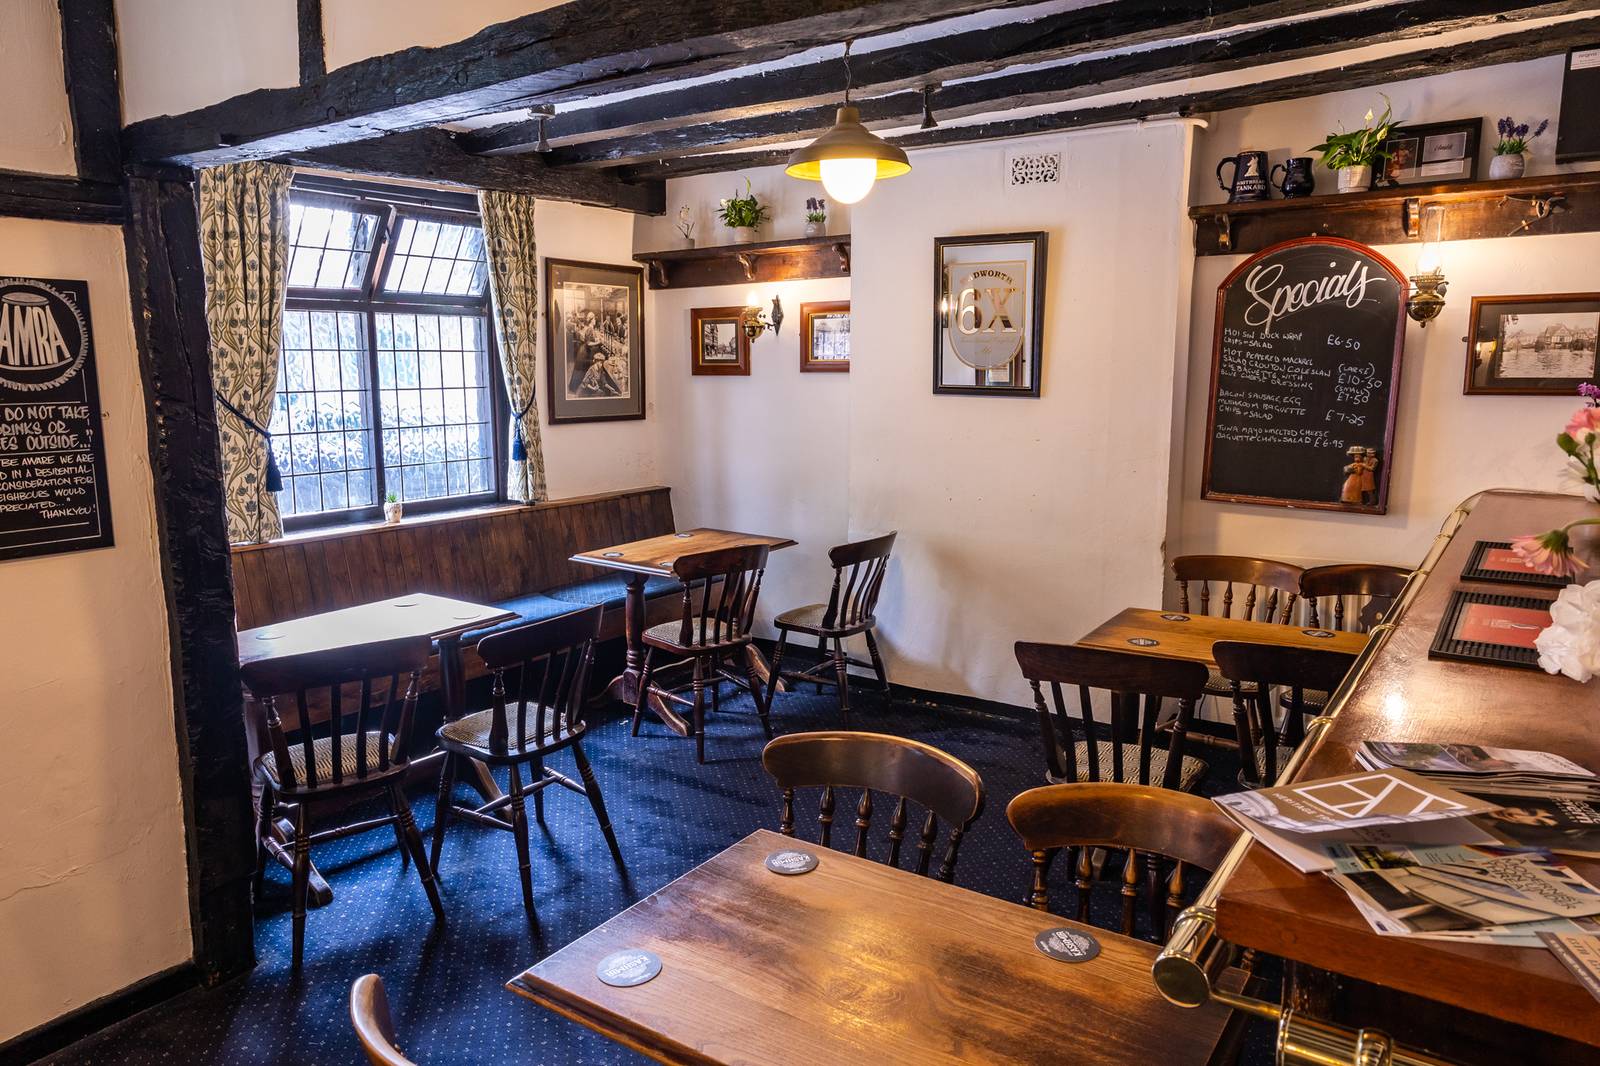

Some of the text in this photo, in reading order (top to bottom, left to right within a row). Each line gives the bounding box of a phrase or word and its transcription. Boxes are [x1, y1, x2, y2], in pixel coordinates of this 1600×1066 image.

[1245, 260, 1387, 335] Specials
[956, 288, 1018, 335] 6X
[0, 303, 72, 366] AMRA
[1224, 328, 1303, 341] HOI SIN DUCK WRAP
[1223, 347, 1243, 357] HOT
[1248, 340, 1273, 349] SALAD
[1223, 354, 1247, 366] SALAD
[1248, 360, 1286, 372] CROUTON
[1287, 365, 1331, 378] COLESLAW
[1237, 366, 1278, 379] BAGUETTE
[1281, 373, 1304, 382] WITH
[1221, 368, 1237, 378] BLUE
[1271, 379, 1314, 390] DRESSING
[1219, 389, 1302, 406] BACON SAUSAGE EGG
[4, 405, 90, 421] DO NOT TAKE
[1217, 399, 1307, 416] MUSHROOM BAGUETTE
[1219, 405, 1242, 415] CHIPS
[1248, 411, 1274, 420] SALAD
[0, 420, 70, 437] RINKS OR
[1217, 424, 1239, 433] TUNA
[1241, 427, 1263, 437] MAYO
[0, 436, 19, 451] ES
[1215, 432, 1256, 442] BAGUETTE
[2, 453, 96, 468] BE AWARE WE ARE
[0, 464, 92, 481] D IN A RESIDENTIAL
[0, 476, 94, 491] ONSIDERATION FOR
[0, 487, 86, 502] EIGHBOURS WOULD
[771, 854, 811, 867] KASHMIR
[1055, 930, 1085, 957] KASHMIR
[605, 955, 649, 978] KASHMIR
